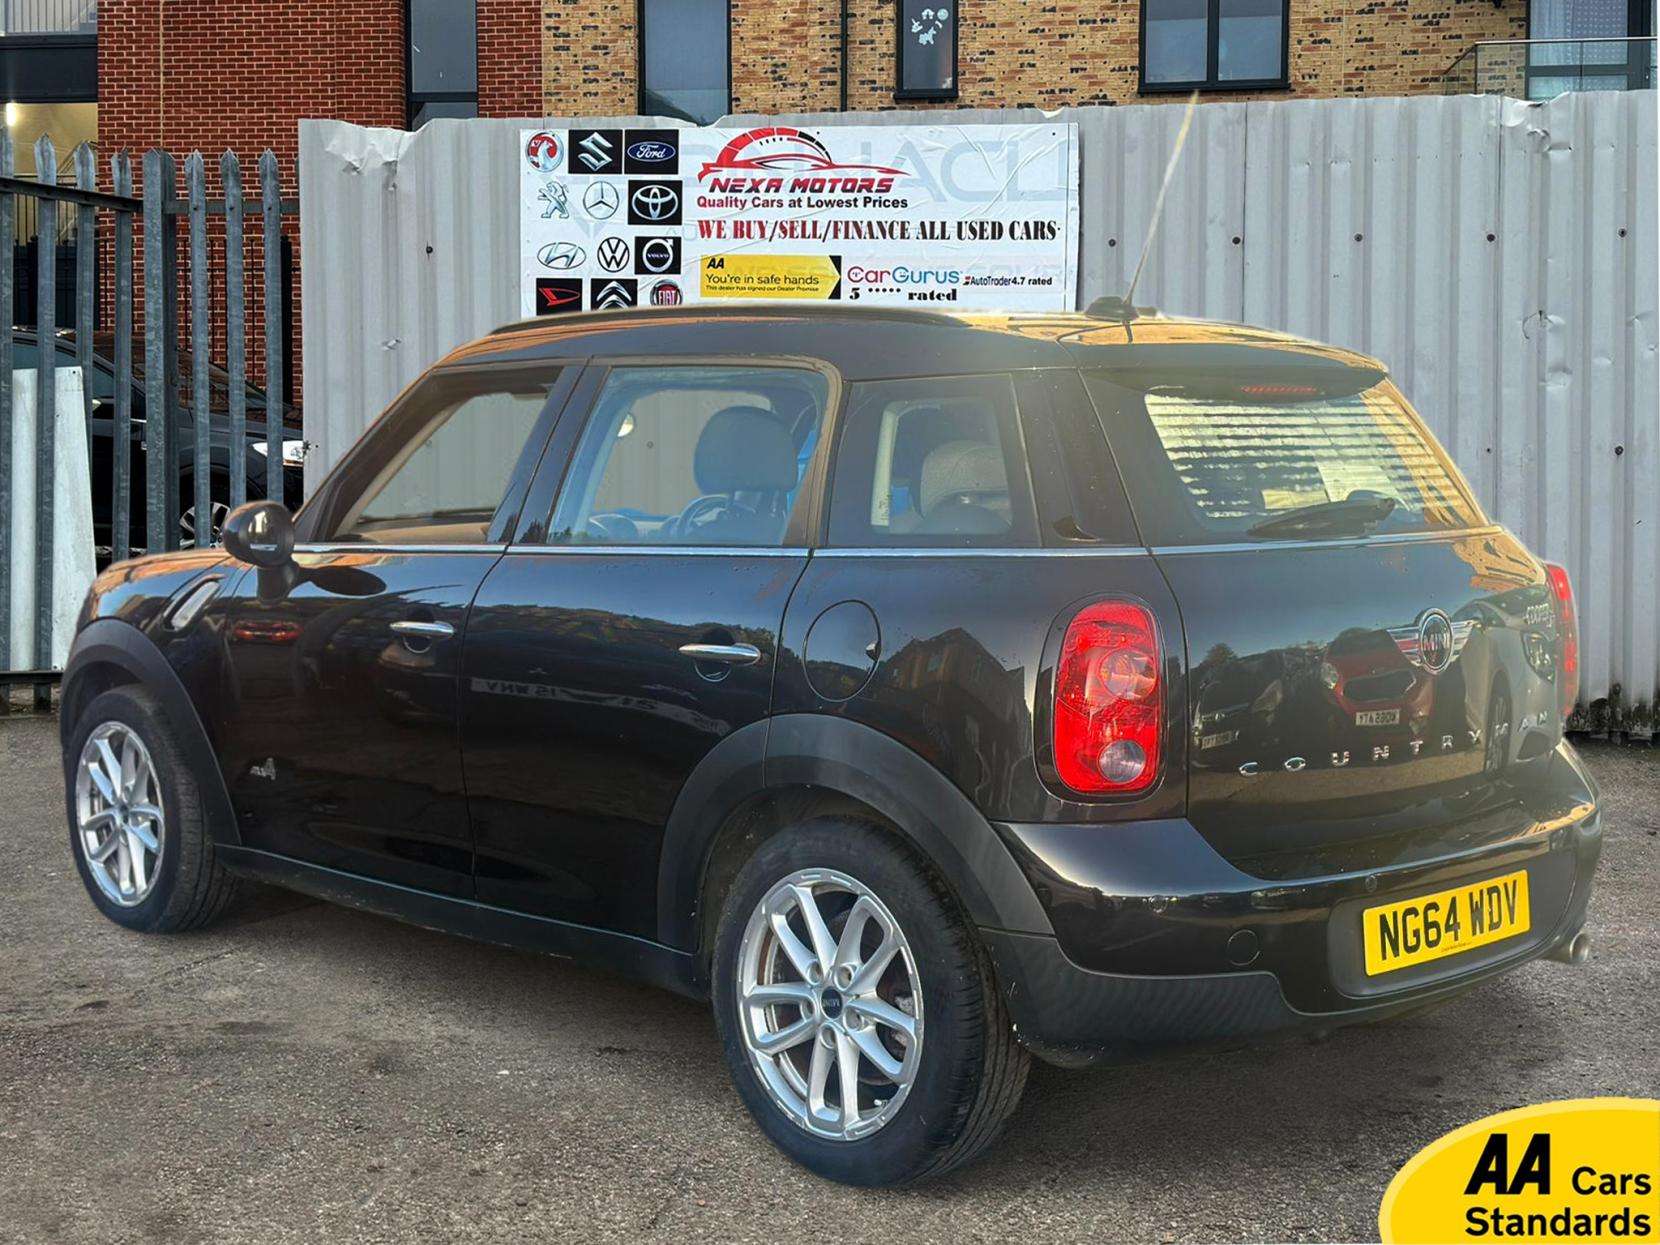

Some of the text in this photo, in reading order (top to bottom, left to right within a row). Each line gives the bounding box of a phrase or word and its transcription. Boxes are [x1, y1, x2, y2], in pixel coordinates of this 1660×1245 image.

[636, 144, 666, 159] Ford
[708, 177, 895, 194] NEXA MOTORS
[697, 196, 908, 211] Quality Cars at Lowest Prices
[697, 219, 727, 240] WE
[916, 220, 951, 241] ALL
[956, 220, 1004, 241] USED
[1009, 220, 1057, 241] CARS
[706, 257, 726, 270] AA
[705, 273, 820, 286] You're in safe hands
[847, 265, 961, 285] CarGurus
[1028, 276, 1053, 286] rated
[658, 289, 677, 305] FIAT
[850, 287, 958, 301] 5 rated
[1238, 711, 1548, 777] COUNTRYMAN
[1379, 879, 1518, 961] NG64 WDV
